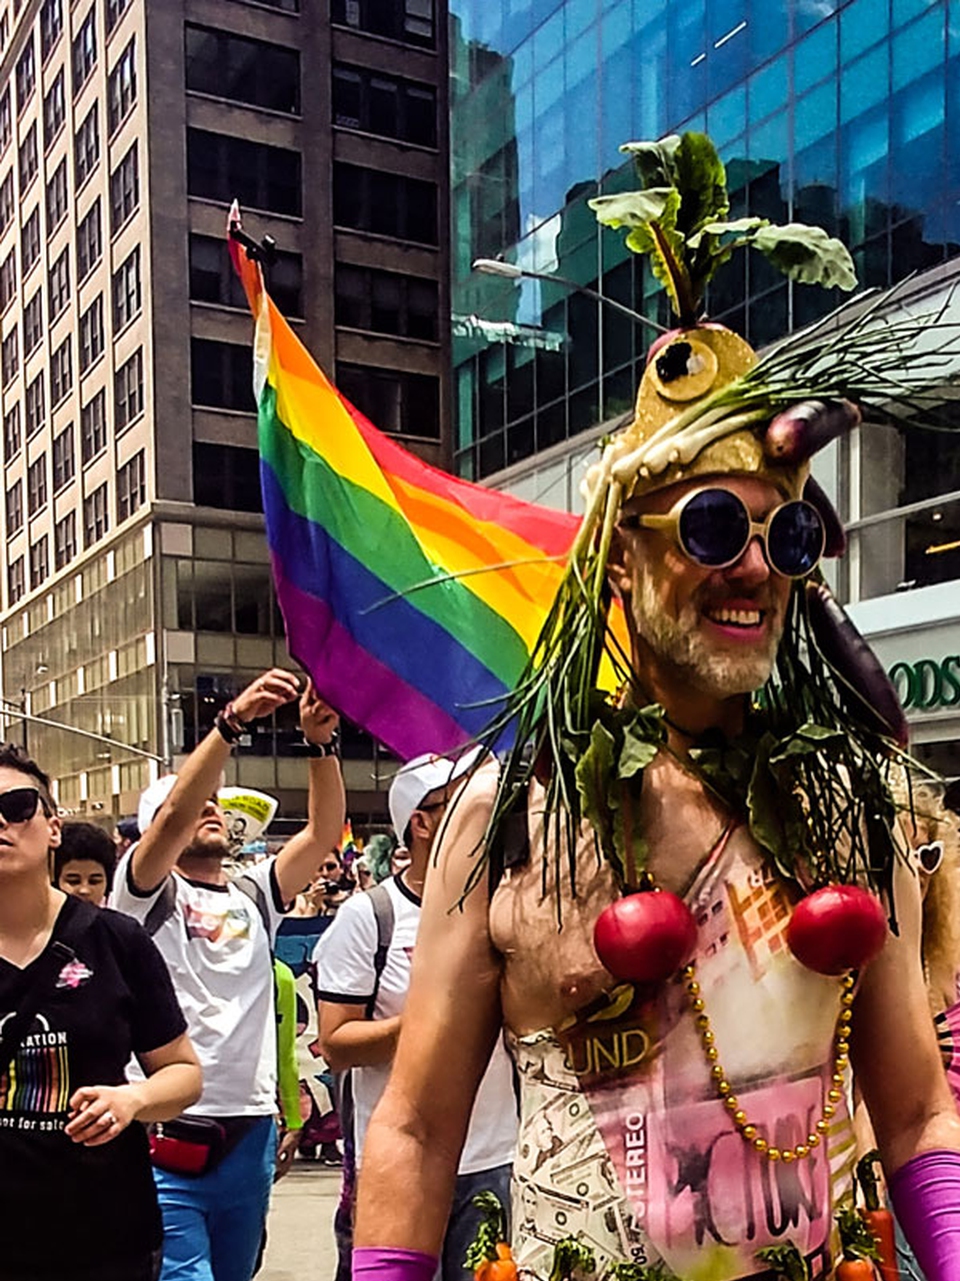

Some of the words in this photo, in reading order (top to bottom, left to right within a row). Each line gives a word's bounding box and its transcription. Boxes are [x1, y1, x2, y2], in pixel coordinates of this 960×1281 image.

[20, 1031, 68, 1048] ATION
[18, 1117, 37, 1130] for
[625, 1111, 646, 1219] STEREO
